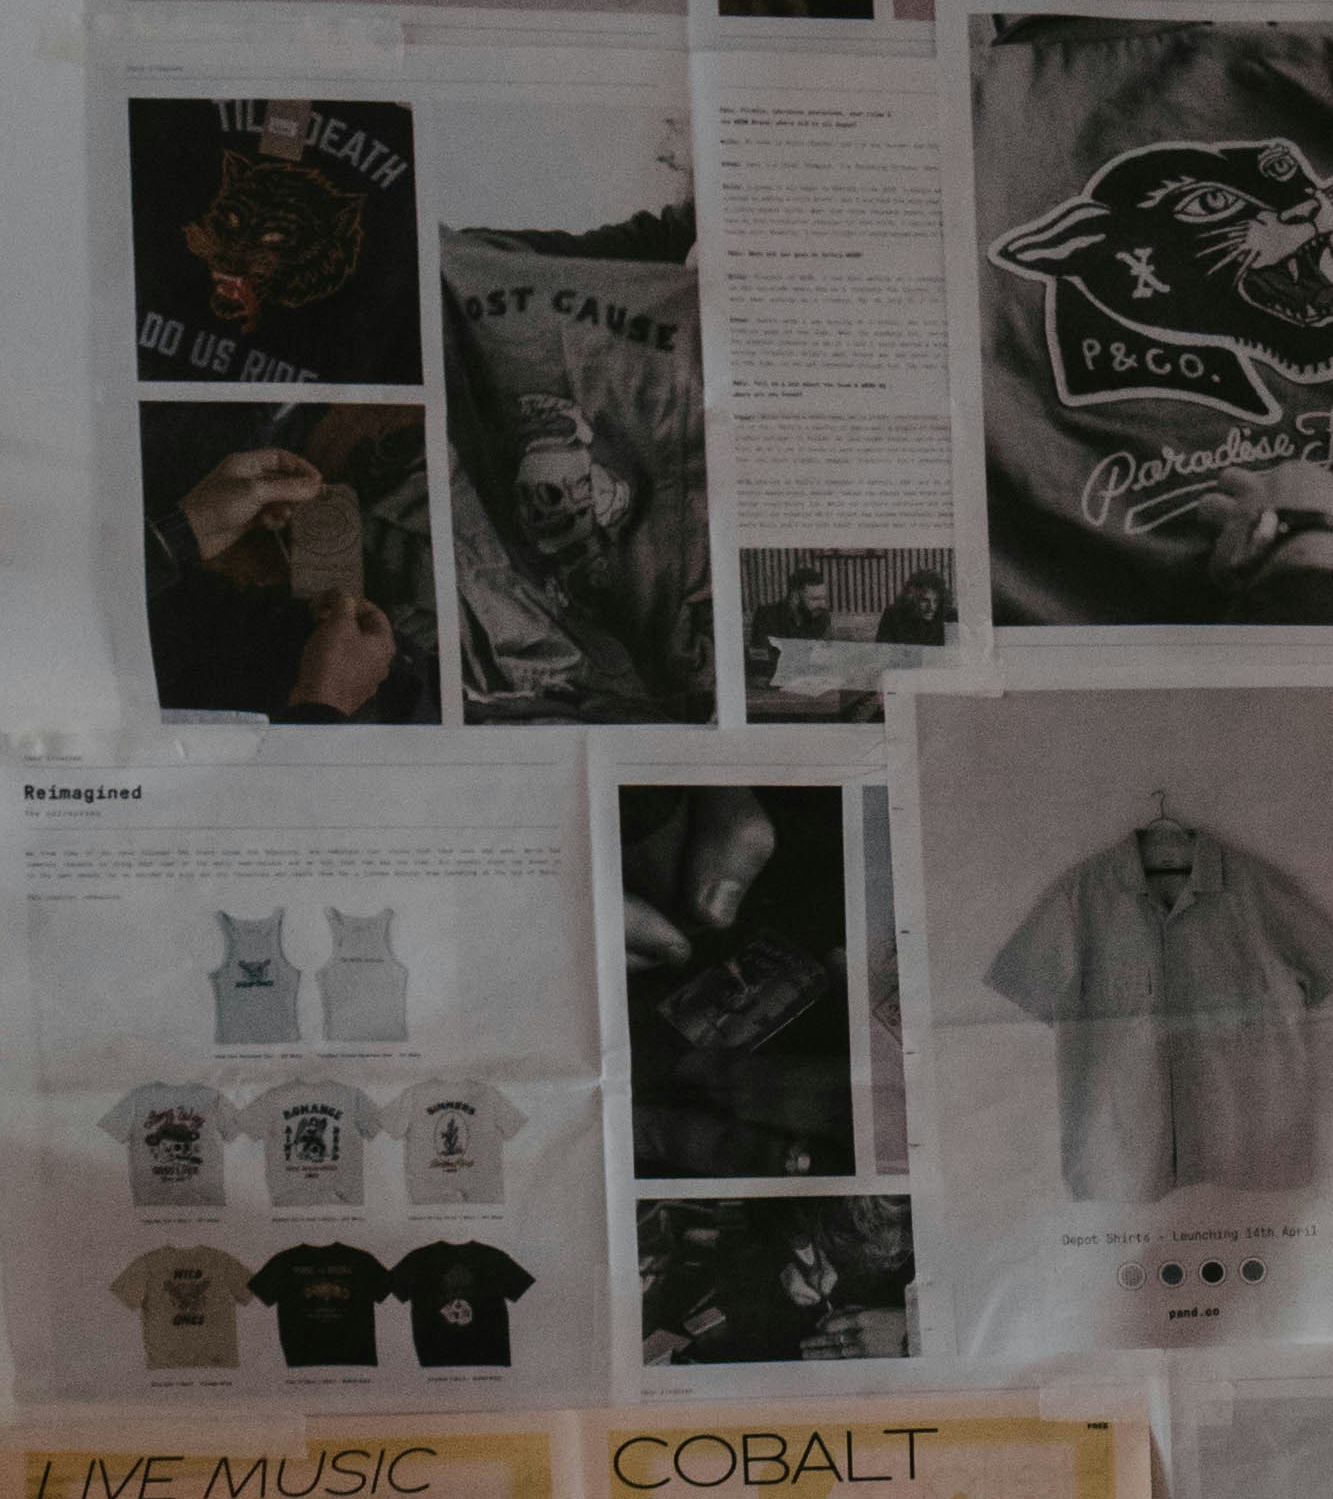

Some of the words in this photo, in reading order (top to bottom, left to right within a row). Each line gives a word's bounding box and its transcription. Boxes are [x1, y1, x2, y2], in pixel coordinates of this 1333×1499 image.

[301, 108, 409, 192] DEATH
[192, 329, 235, 373] US
[1080, 336, 1224, 386] P&CO.
[1080, 426, 1296, 528] Paradise
[23, 783, 144, 806] Reimagined
[202, 1445, 440, 1499] MUSIC
[611, 1427, 940, 1491] COBALT
